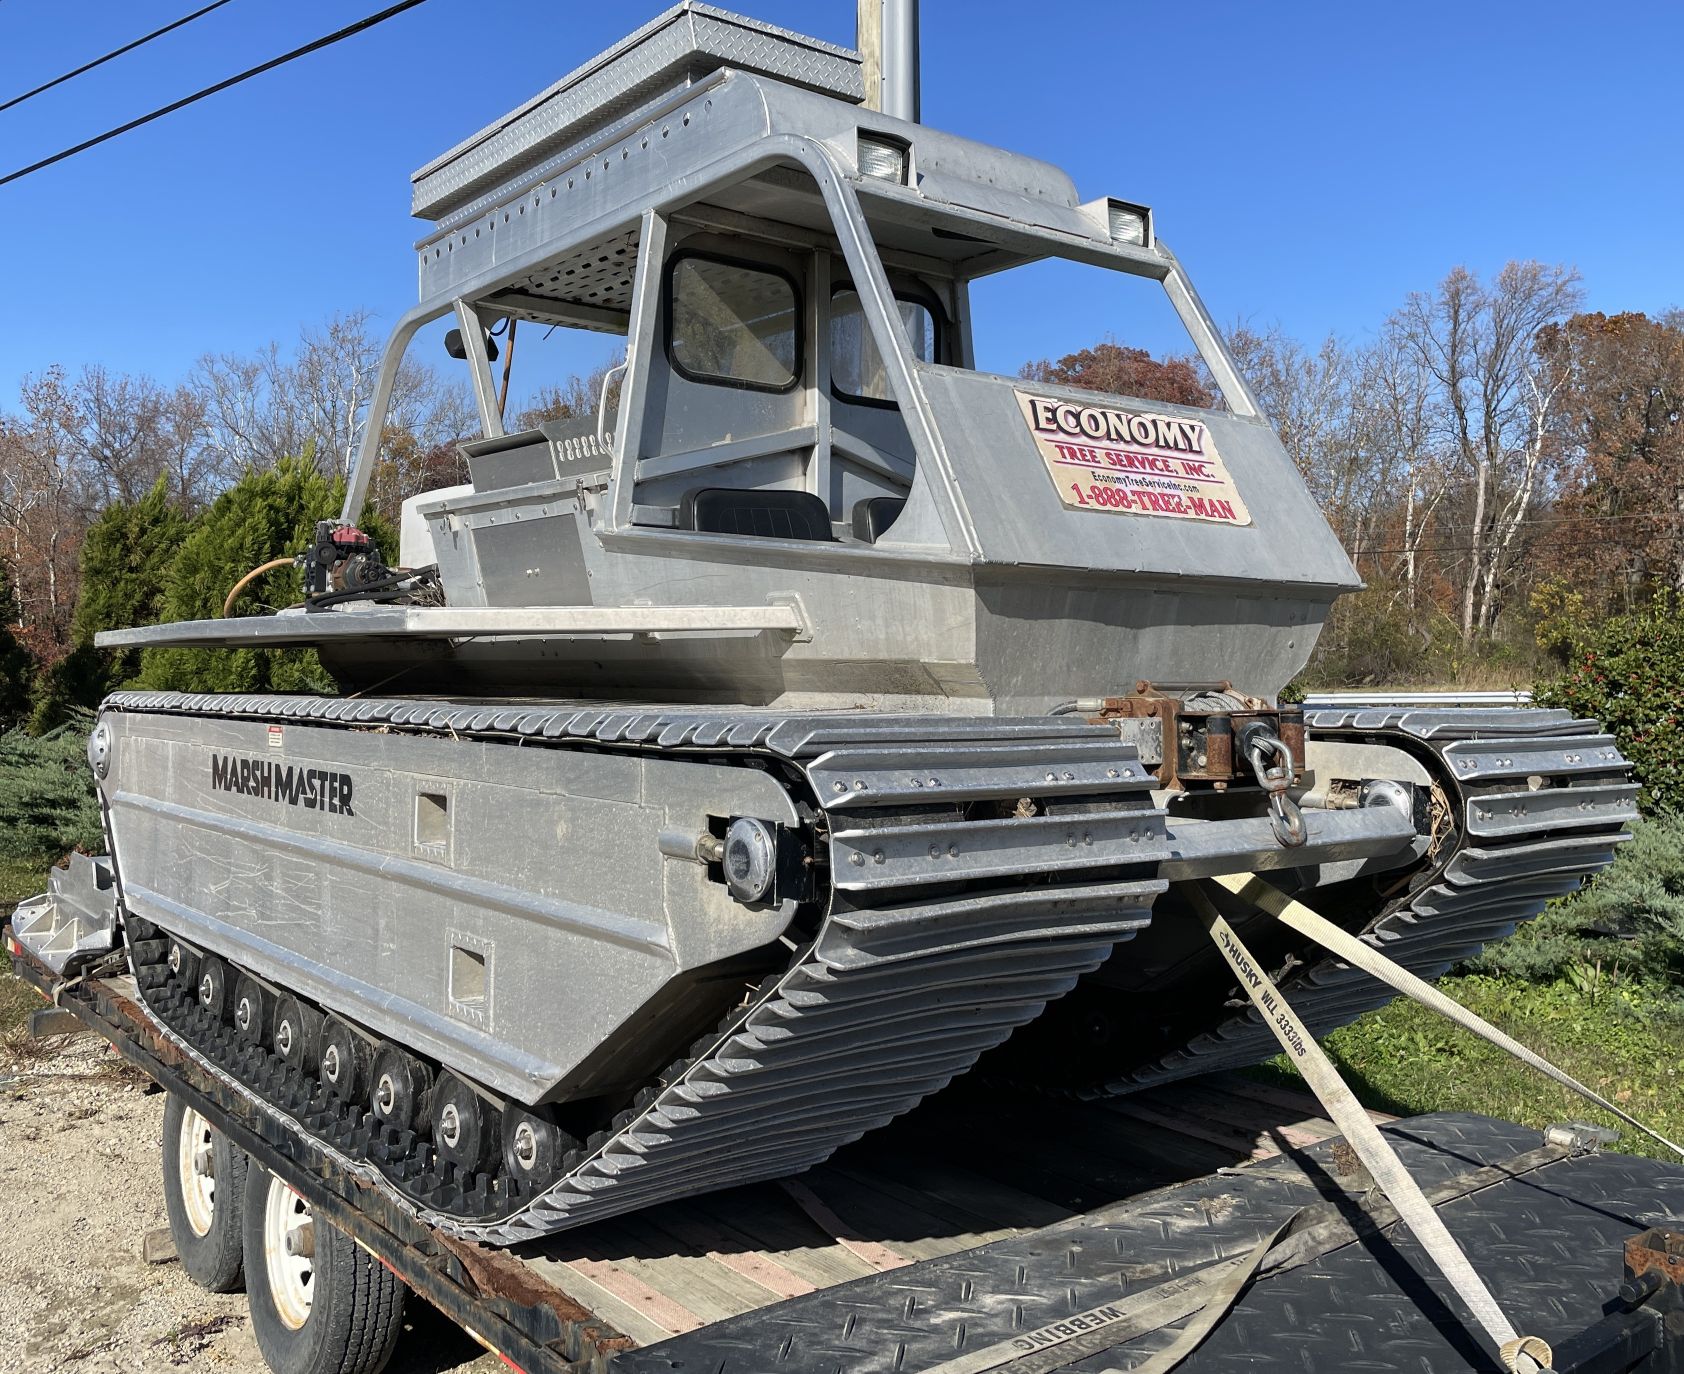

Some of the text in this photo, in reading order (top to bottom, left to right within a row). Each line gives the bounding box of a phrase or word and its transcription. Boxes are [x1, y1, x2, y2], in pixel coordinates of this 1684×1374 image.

[1029, 399, 1203, 454] ECONOMY
[1054, 444, 1216, 479] TREE SERVICE, INC.
[1091, 470, 1200, 494] EconomyTreeServiceInc.com
[1071, 482, 1237, 520] 1-888-TREE-MAN
[1228, 943, 1307, 1057] HUSKY WLL 3333lbs
[1011, 1305, 1127, 1351] WEBBING
